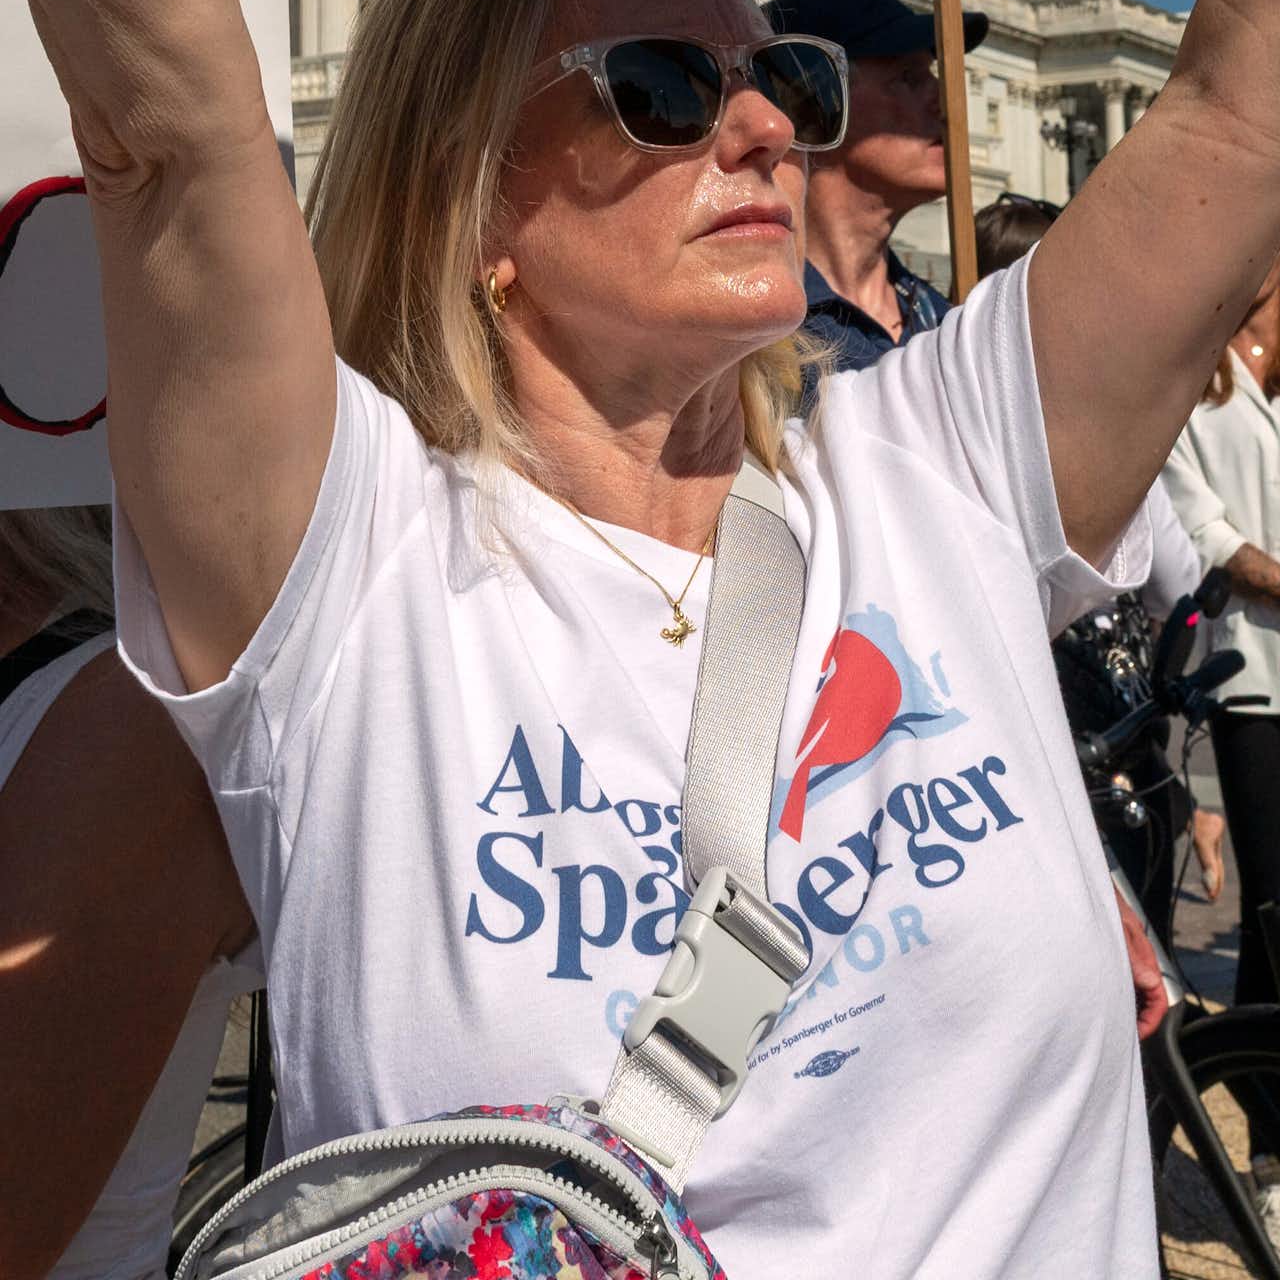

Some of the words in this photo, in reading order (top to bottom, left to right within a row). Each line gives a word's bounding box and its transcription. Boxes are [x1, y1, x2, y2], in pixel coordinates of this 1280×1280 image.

[770, 1043, 781, 1055] by
[781, 1018, 833, 1048] Spanberger
[833, 1012, 847, 1024] for
[848, 992, 886, 1017] Governor
